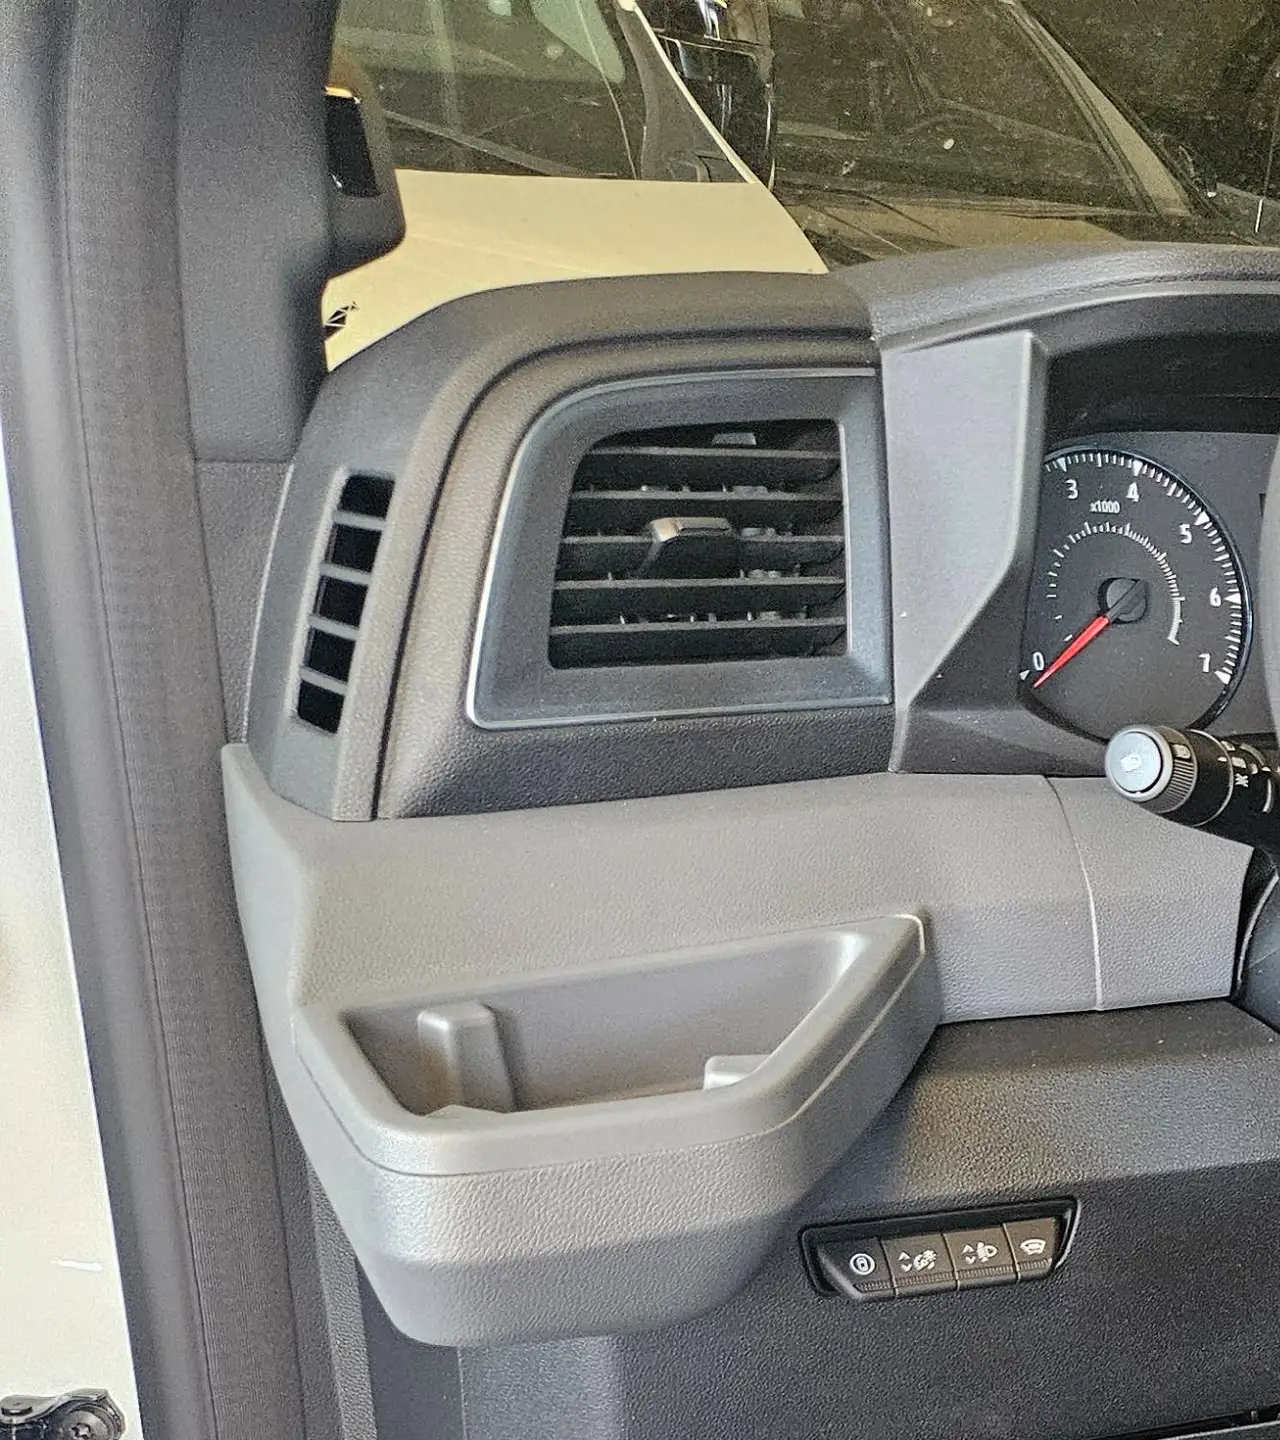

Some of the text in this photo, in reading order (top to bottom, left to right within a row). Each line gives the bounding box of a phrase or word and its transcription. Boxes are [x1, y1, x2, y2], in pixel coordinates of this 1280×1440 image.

[1066, 479, 1079, 500] 3
[1126, 482, 1140, 503] 4
[1180, 524, 1192, 545] 5
[1209, 588, 1222, 608] 6
[1032, 651, 1045, 672] 0
[1199, 654, 1211, 673] 7
